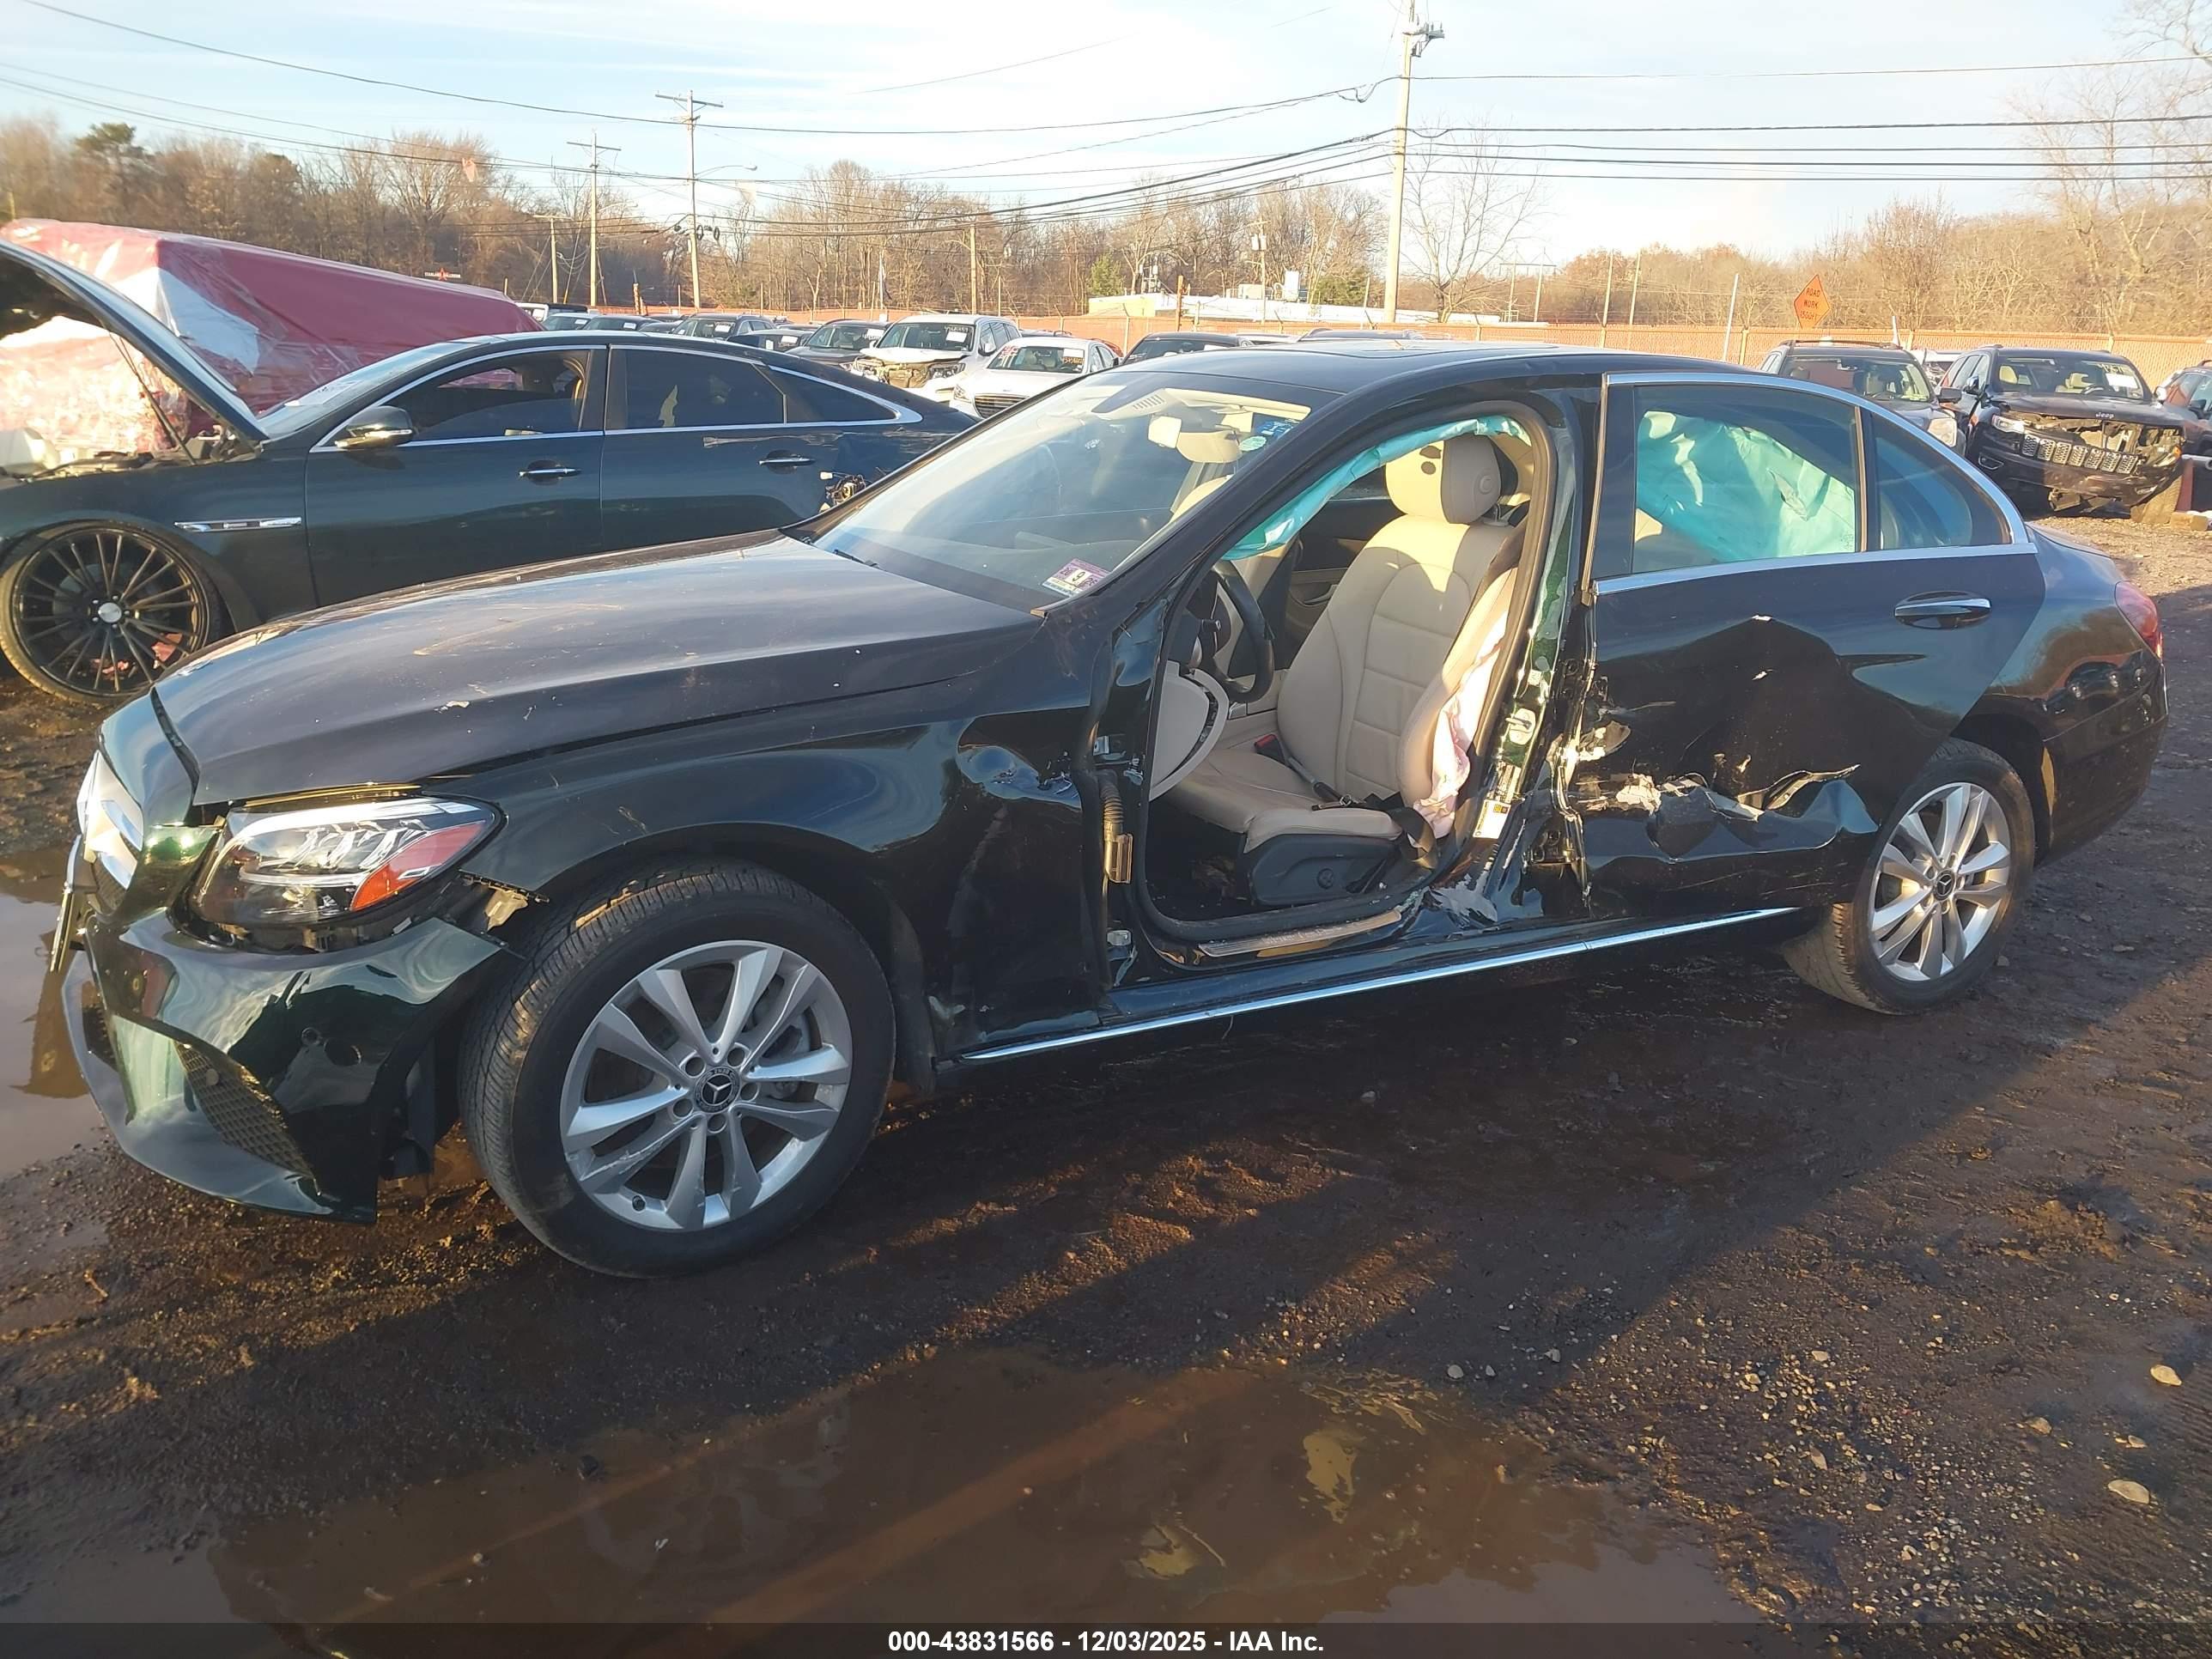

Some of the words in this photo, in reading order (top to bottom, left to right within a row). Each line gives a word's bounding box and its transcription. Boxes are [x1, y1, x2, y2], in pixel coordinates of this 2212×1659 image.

[1806, 288, 1820, 297] ROAD
[1803, 300, 1819, 309] WORK
[1072, 571, 1086, 582] 9
